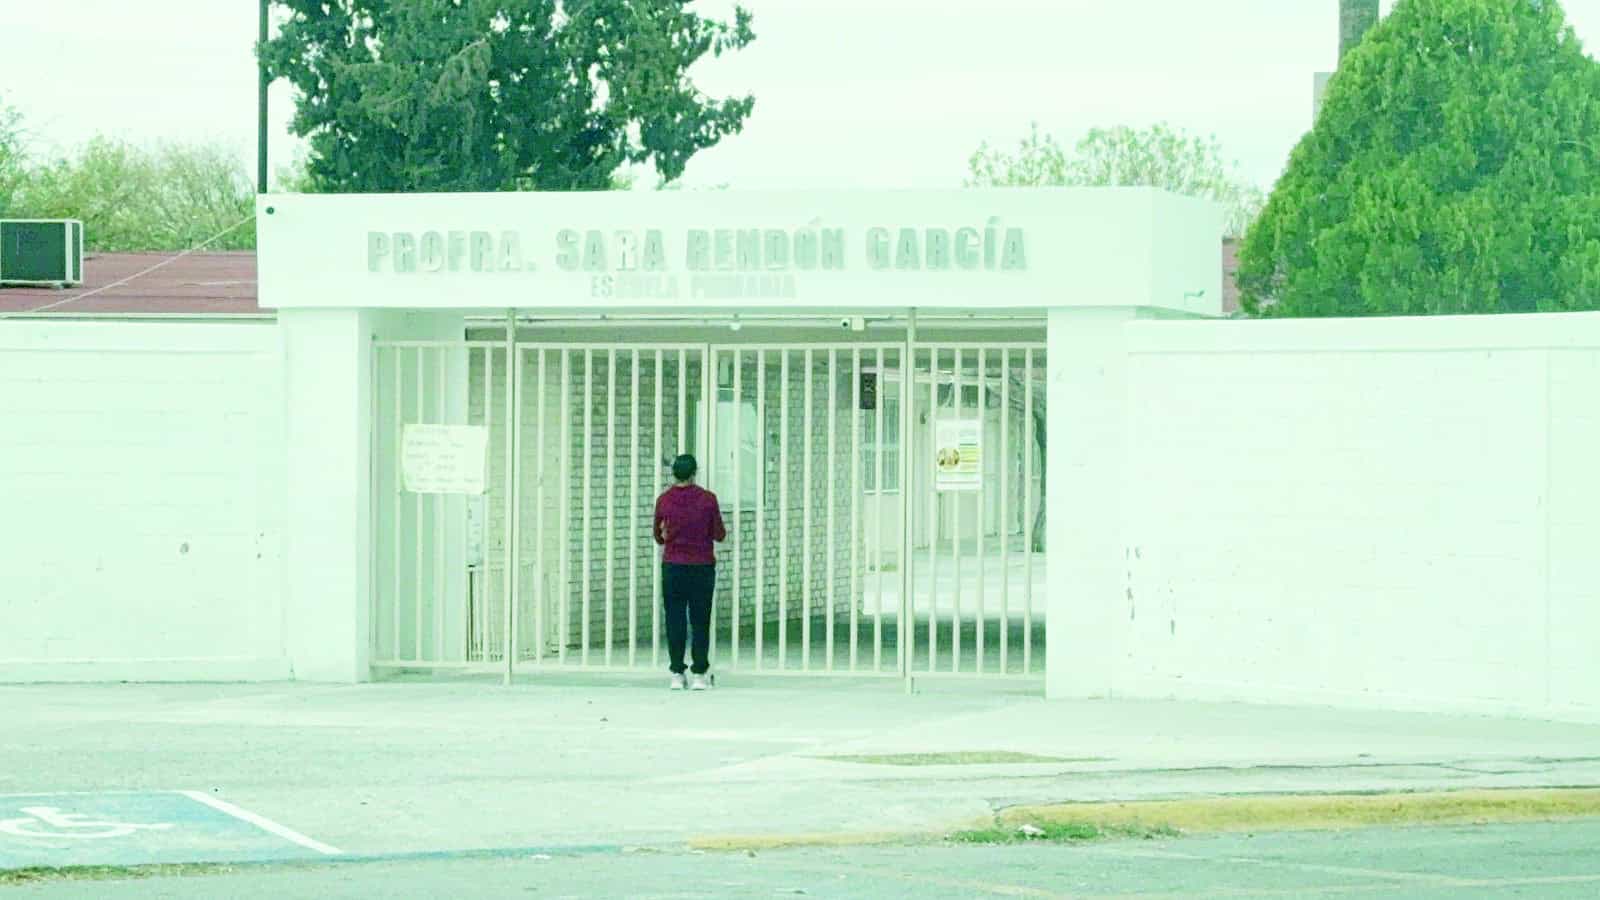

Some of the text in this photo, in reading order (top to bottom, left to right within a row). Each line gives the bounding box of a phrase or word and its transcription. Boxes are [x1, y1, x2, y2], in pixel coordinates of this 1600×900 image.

[367, 215, 1028, 272] PROFRA. SARA RENDÓN GARCÍA
[691, 273, 797, 297] PARIA
